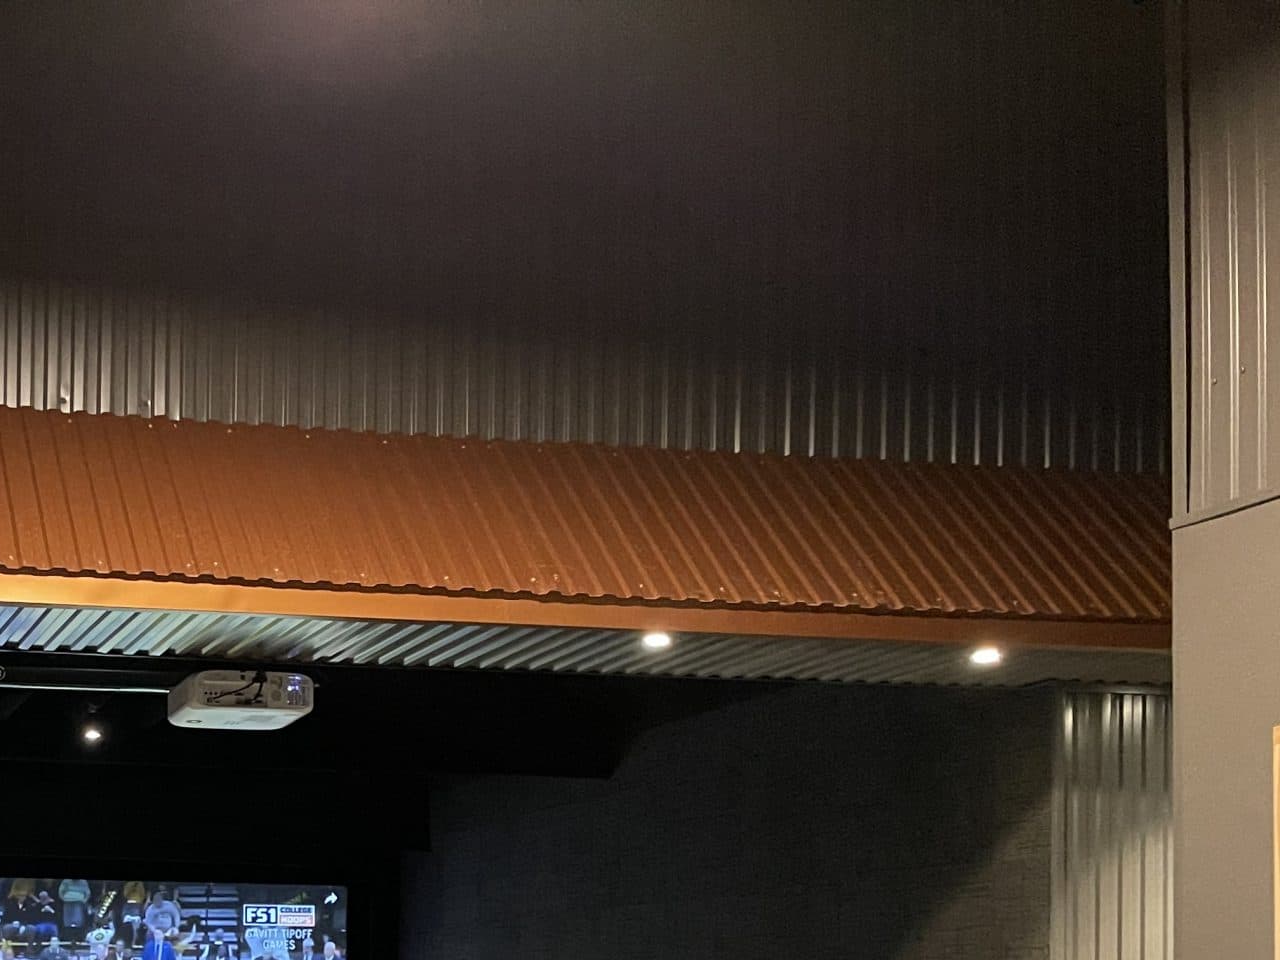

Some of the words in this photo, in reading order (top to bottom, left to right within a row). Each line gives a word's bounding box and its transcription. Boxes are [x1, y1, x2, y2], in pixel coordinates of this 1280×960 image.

[246, 907, 277, 923] FS1
[281, 928, 313, 940] TIPOFF
[263, 939, 296, 951] GAMES
